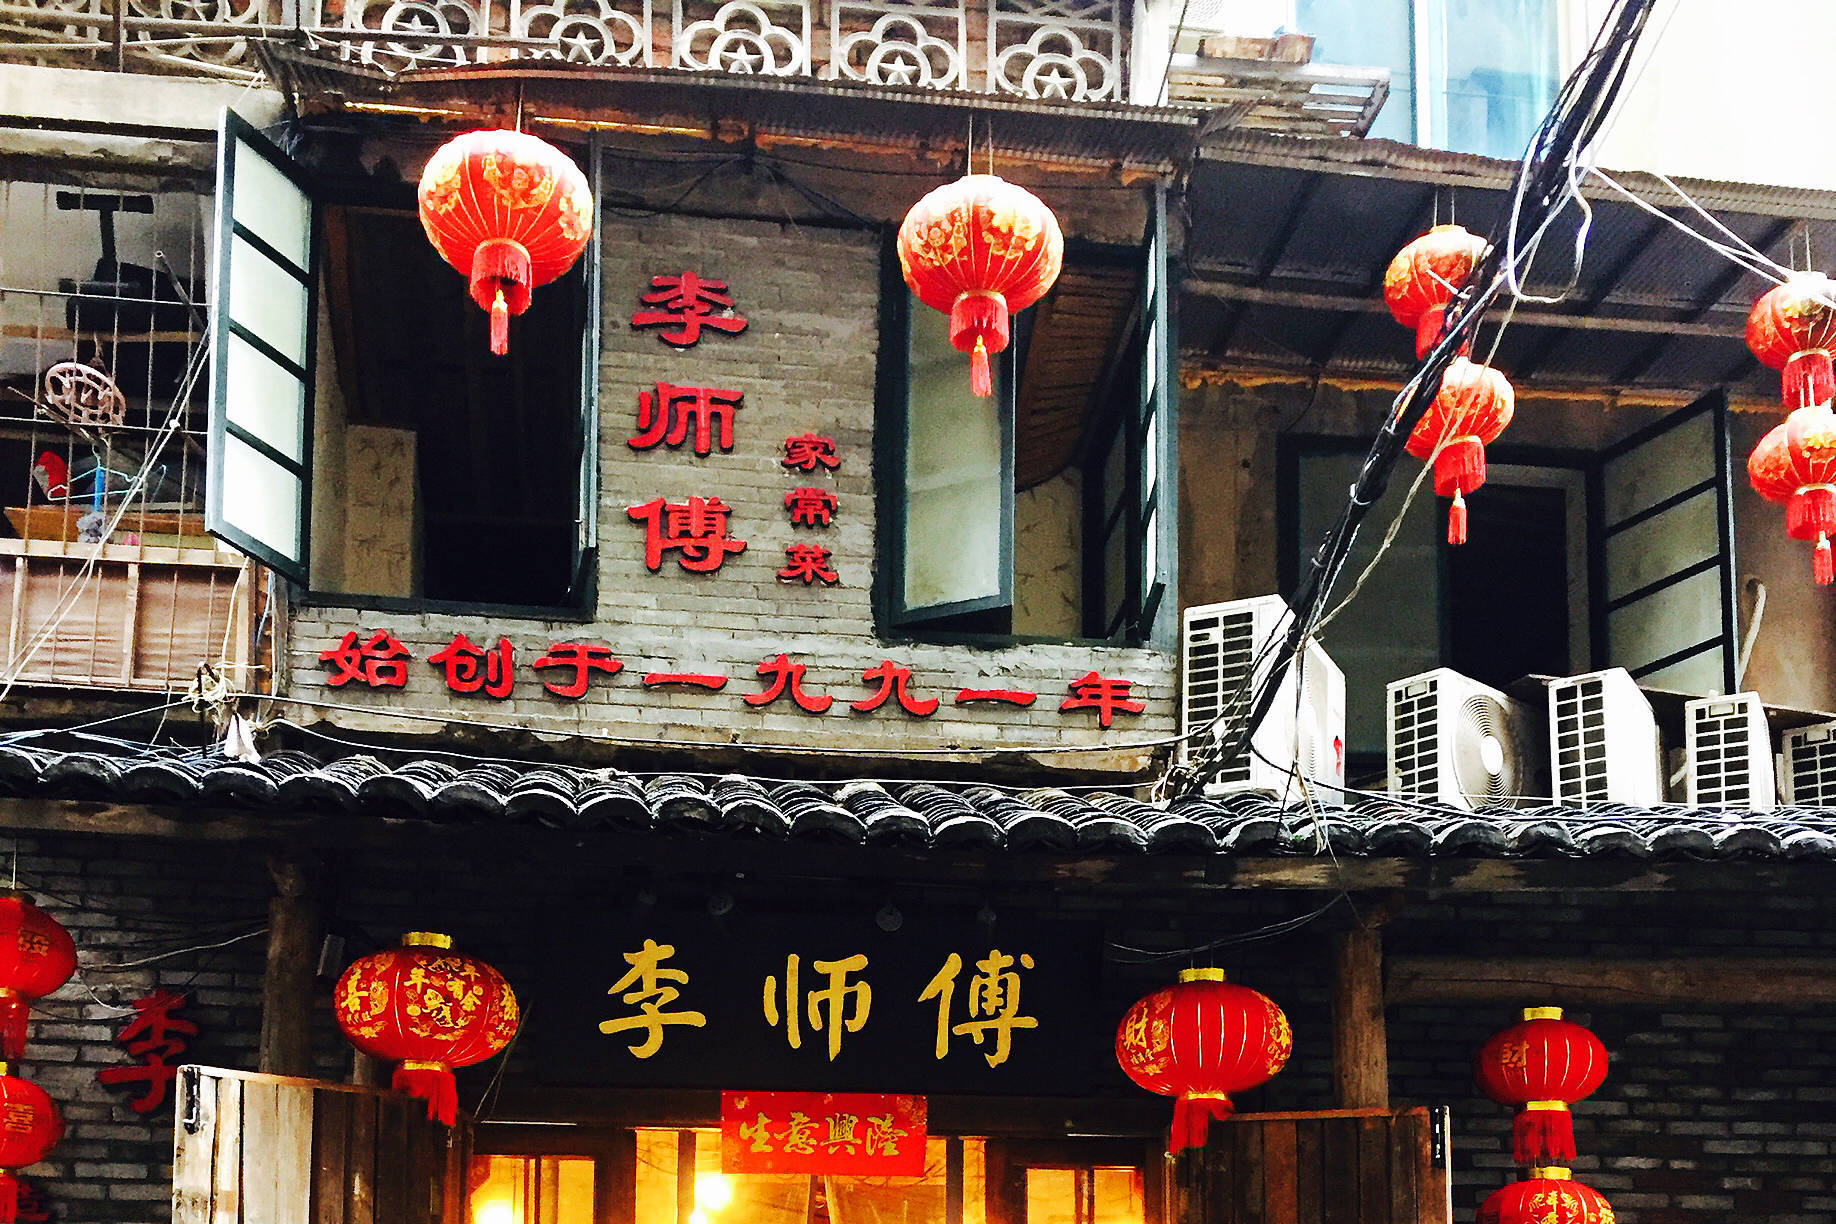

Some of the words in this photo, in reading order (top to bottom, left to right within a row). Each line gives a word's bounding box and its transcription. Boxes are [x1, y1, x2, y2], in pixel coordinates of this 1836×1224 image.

[627, 271, 749, 574] 李师傅
[780, 433, 841, 585] 家常菜
[318, 627, 1146, 728] 始创于一九九一年
[598, 939, 1039, 1069] 李师傅
